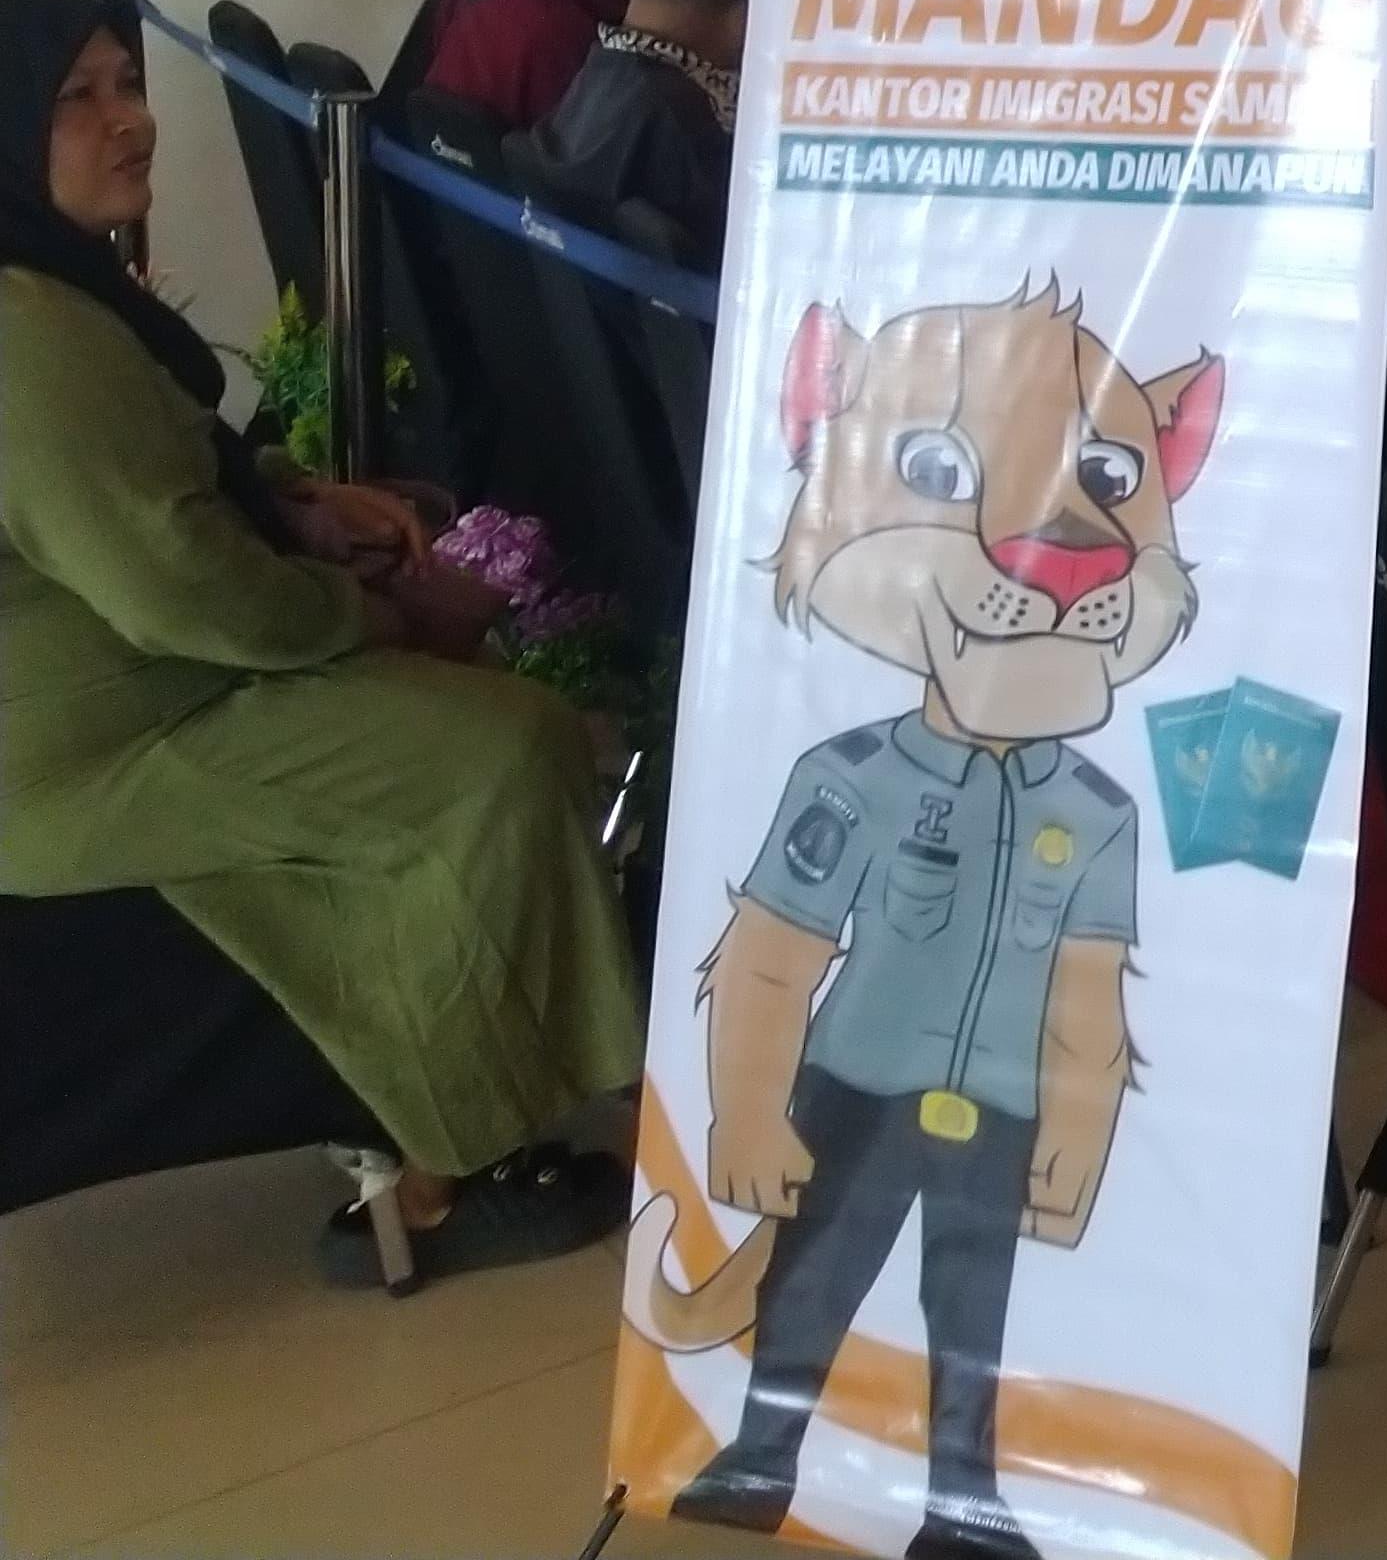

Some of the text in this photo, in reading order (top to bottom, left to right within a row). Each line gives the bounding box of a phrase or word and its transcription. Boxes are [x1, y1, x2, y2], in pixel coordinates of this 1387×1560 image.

[790, 74, 1340, 129] KANTOR IMIGRASI SAM
[785, 142, 1367, 196] MELAYANI ANDA DIMANAPUN
